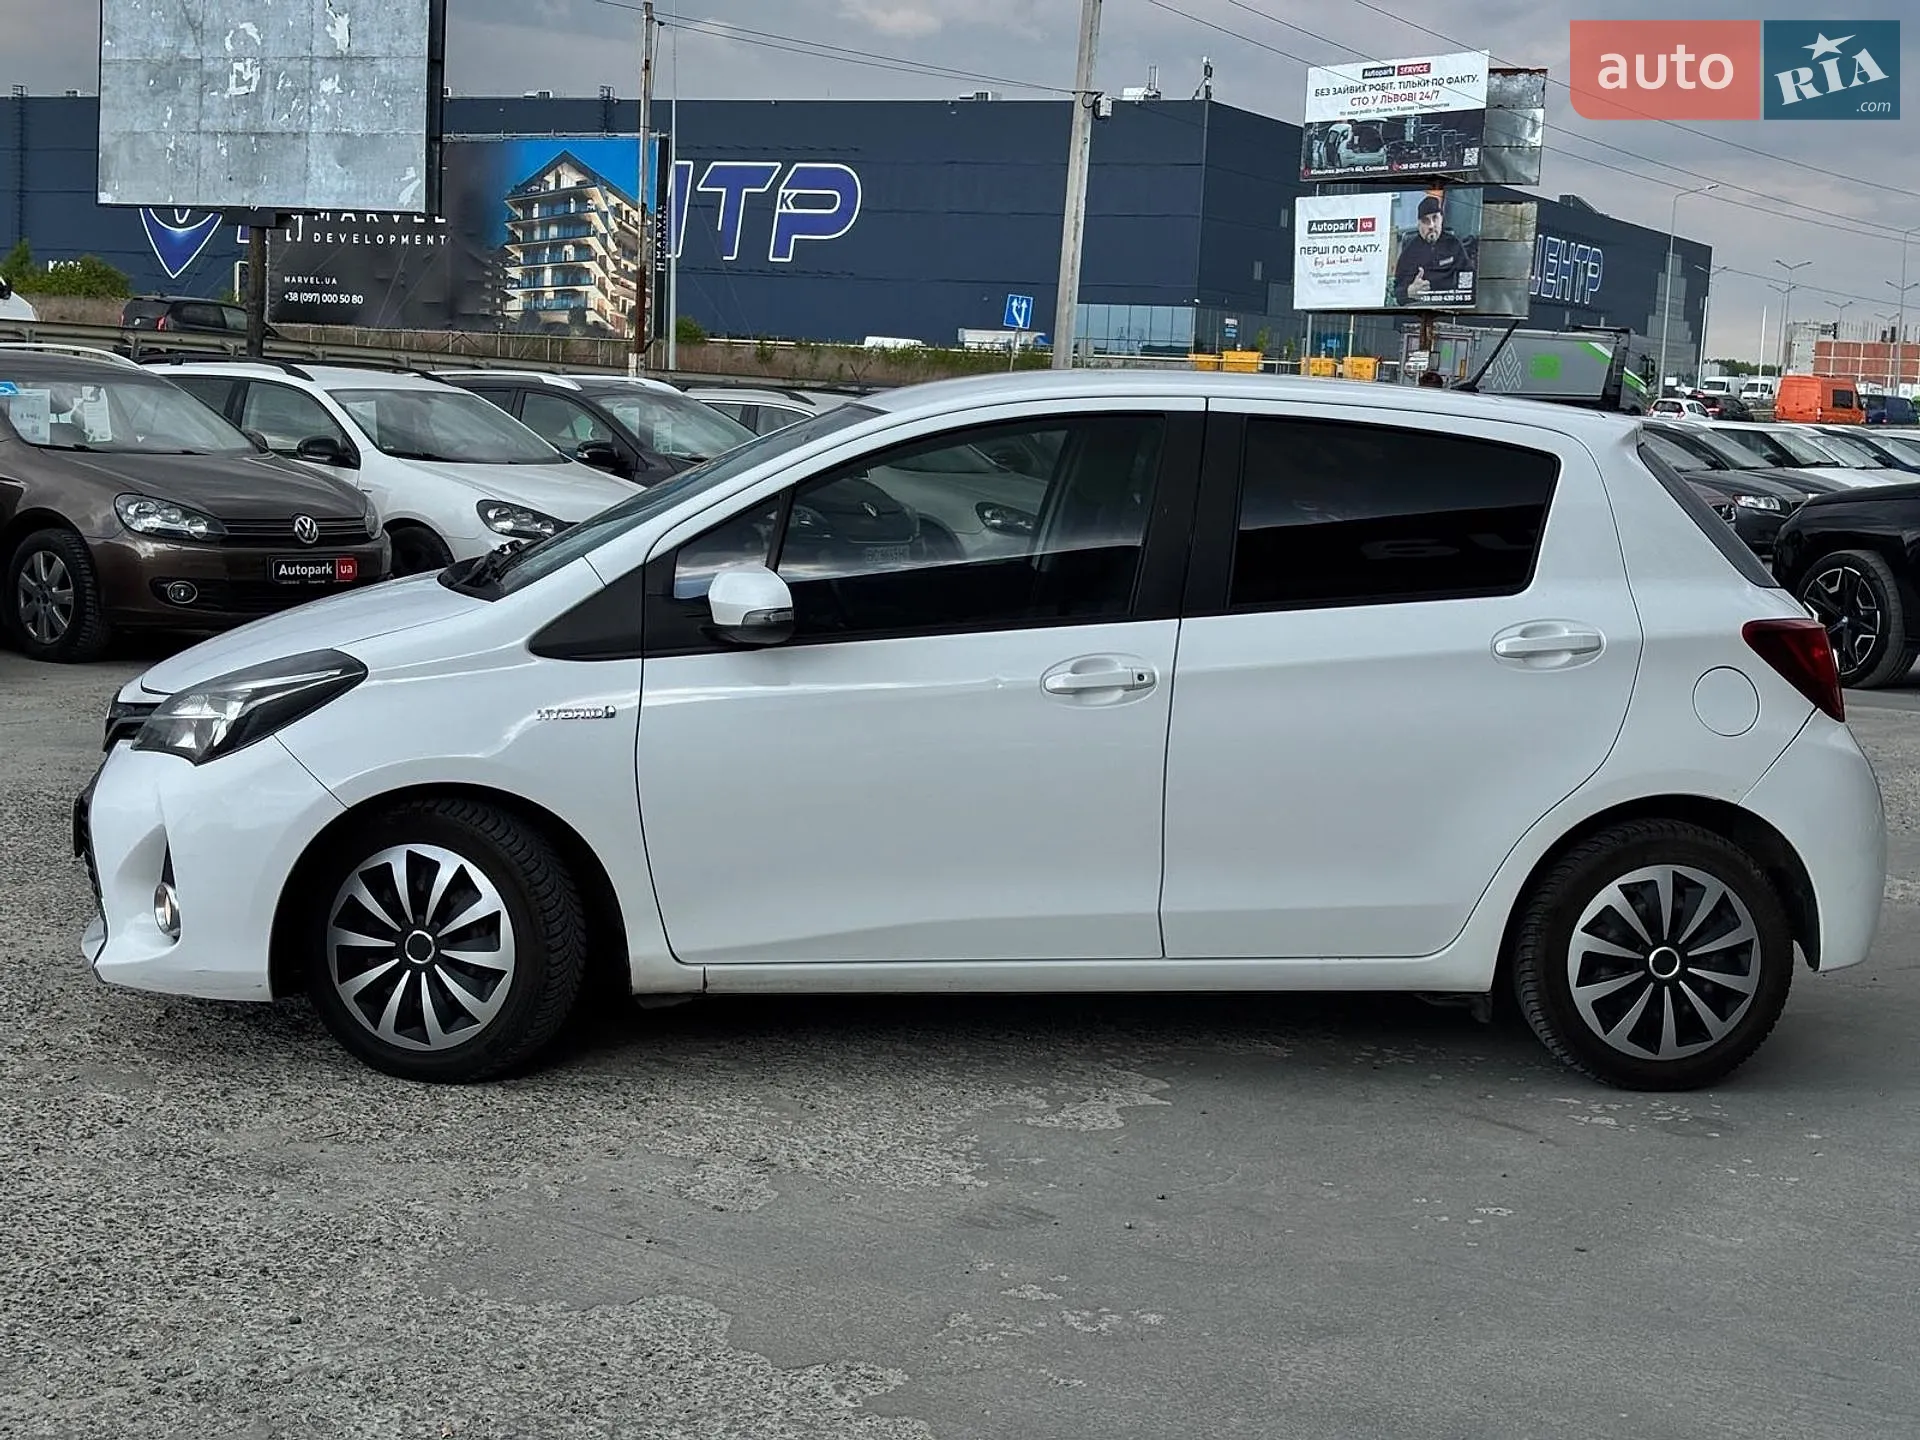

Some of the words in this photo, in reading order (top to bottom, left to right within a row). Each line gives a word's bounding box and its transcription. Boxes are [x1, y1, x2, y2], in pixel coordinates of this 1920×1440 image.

[1364, 67, 1394, 78] Autopark
[1399, 64, 1429, 76] SERVICE
[1315, 87, 1331, 98] БЕЗ
[1332, 84, 1366, 95] ЗАЙВИХ
[1399, 78, 1429, 90] ТІЛЬКИ
[1431, 77, 1444, 87] ПО
[1446, 74, 1479, 86] ФАКТУ.
[1351, 95, 1369, 107] СТО
[1371, 95, 1379, 105] У
[1381, 92, 1417, 104] ЛЬВОВІ
[1419, 90, 1440, 101] 24/7
[1310, 220, 1355, 233] Autopark
[313, 232, 449, 246] DEVELOPMENT
[1300, 245, 1330, 256] ПЕРШІ
[1332, 245, 1347, 254] ПО
[1347, 243, 1383, 254] ФАКТУ.
[284, 275, 338, 285] MARVEL.UA
[284, 291, 299, 302] +38
[300, 292, 321, 305] (097)
[322, 293, 339, 304] 000
[339, 294, 351, 304] 50
[278, 562, 333, 578] Autopark
[340, 565, 353, 574] ua
[535, 708, 604, 721] HYBRID
